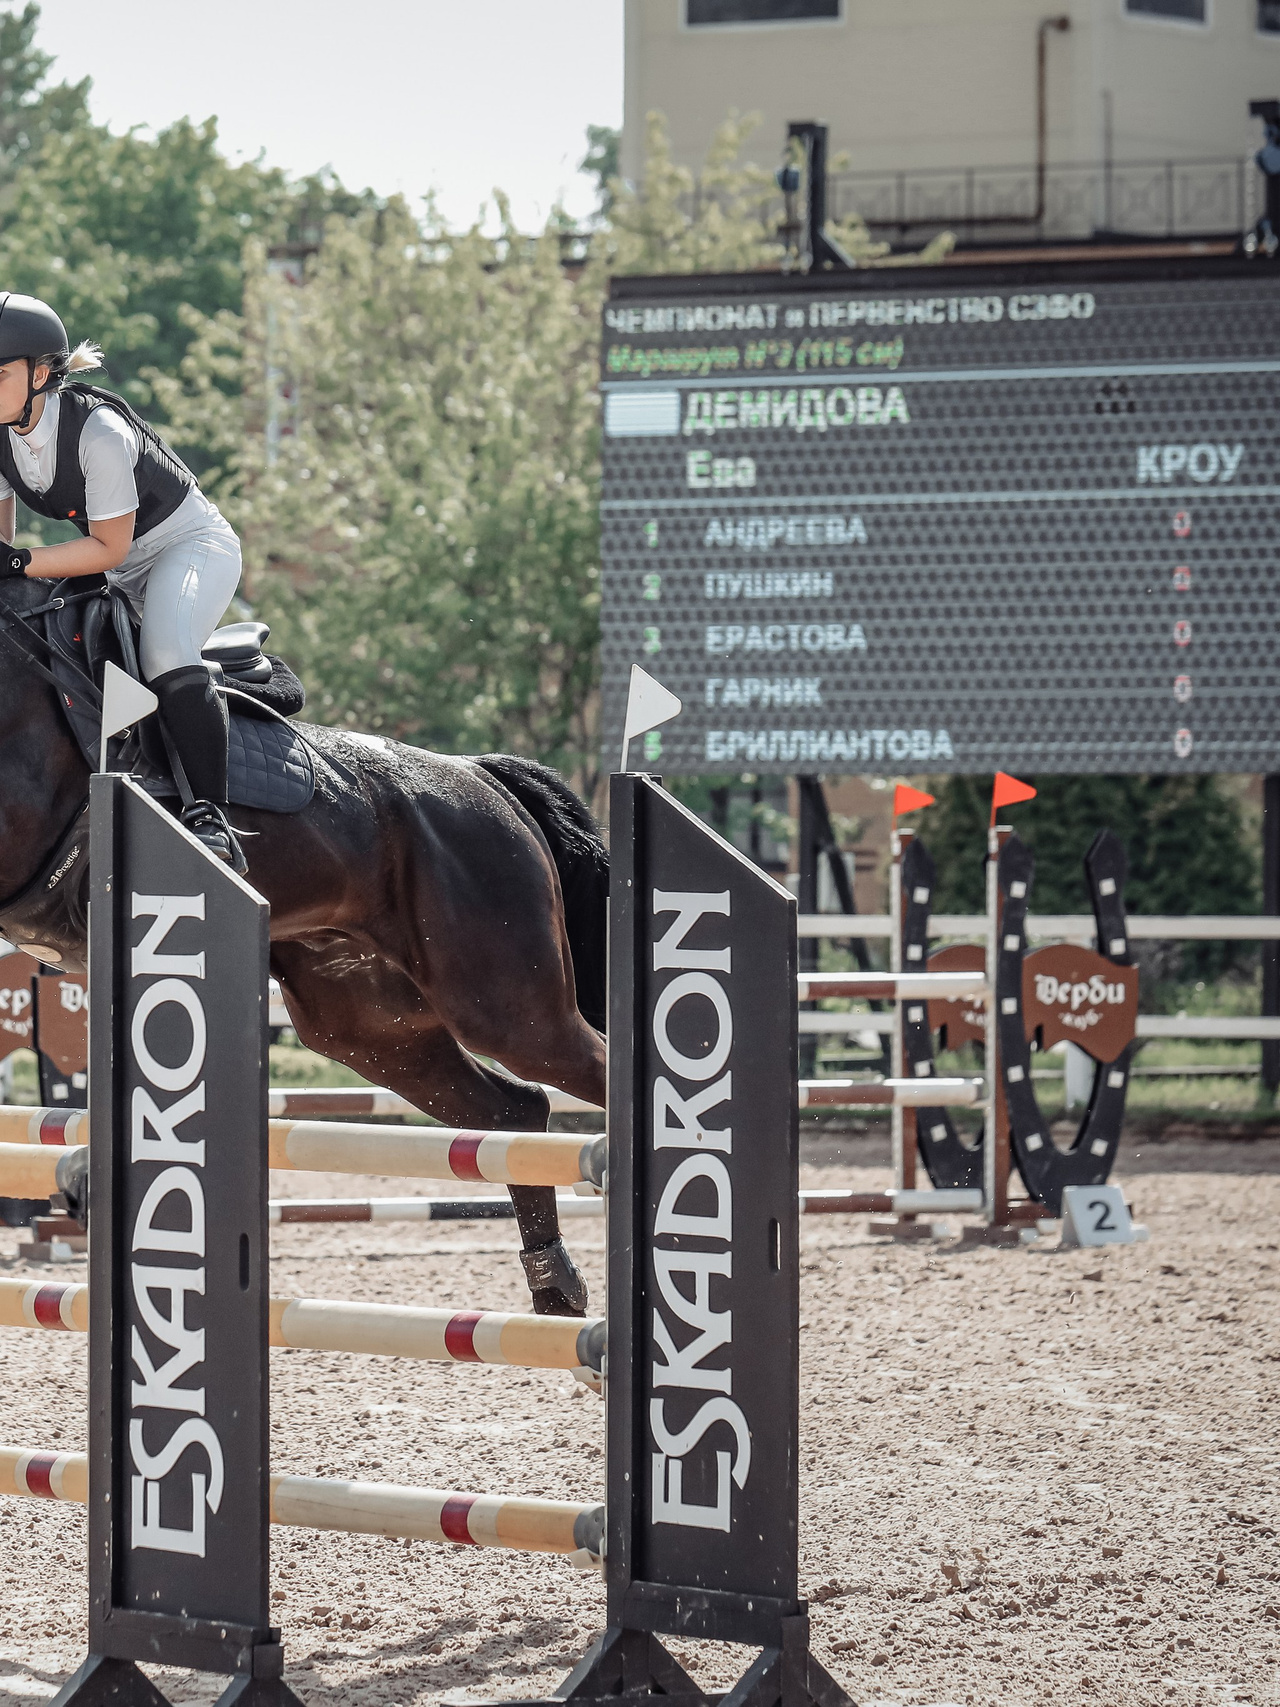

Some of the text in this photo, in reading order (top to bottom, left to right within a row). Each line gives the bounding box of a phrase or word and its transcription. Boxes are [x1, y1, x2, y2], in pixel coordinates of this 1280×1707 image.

[605, 303, 778, 333] ЧЕМПИОНАТ
[809, 296, 1003, 327] ПЕРВЕНСТВО
[683, 387, 911, 435] ДЕМИДОВА
[686, 450, 756, 488] Ева
[1135, 442, 1245, 483] КРОУ
[704, 514, 868, 551] АНДРЕЕВА
[1173, 511, 1191, 537] 0
[704, 571, 834, 599] ПУШКИН
[704, 624, 868, 653] ЕРАСТОВА
[1173, 621, 1192, 647] 0
[704, 675, 1193, 708] ГАРНИК 0
[704, 729, 955, 762] БРИЛЛИАНТОВА
[1174, 729, 1193, 758] 0
[130, 890, 226, 1559] ESKADRON
[650, 888, 752, 1534] ESKADRON
[1087, 1200, 1116, 1231] 2
